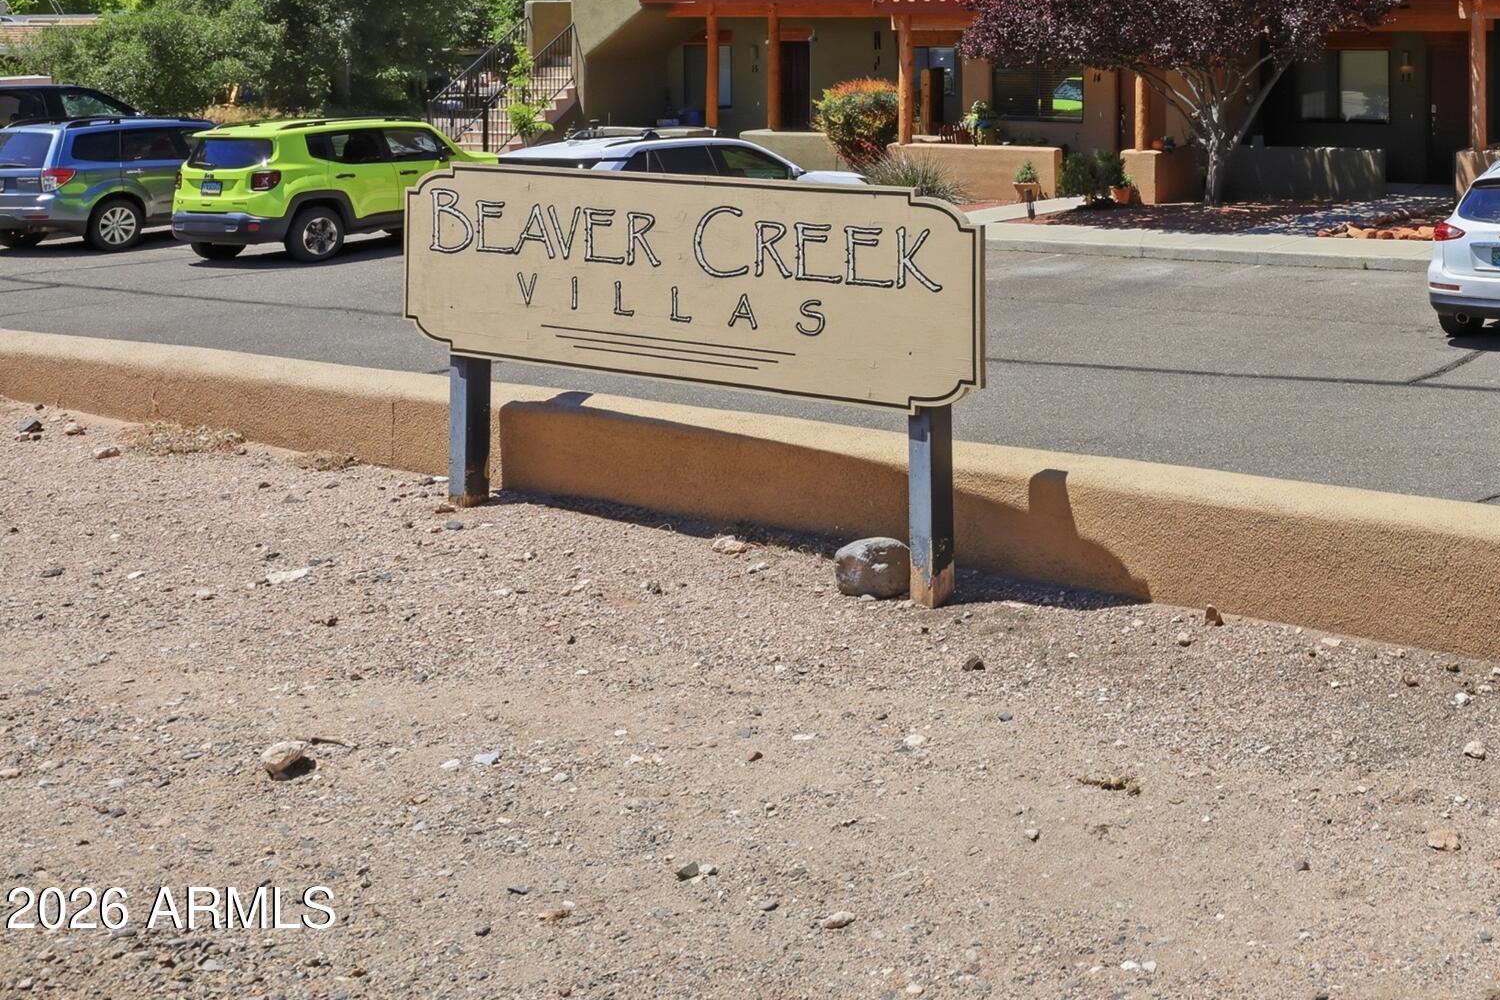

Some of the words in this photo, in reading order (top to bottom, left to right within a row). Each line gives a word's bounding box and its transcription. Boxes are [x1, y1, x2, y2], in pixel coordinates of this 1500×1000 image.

[428, 188, 663, 268] BEAVER
[693, 205, 944, 293] CREEK
[516, 271, 827, 337] VILLAS
